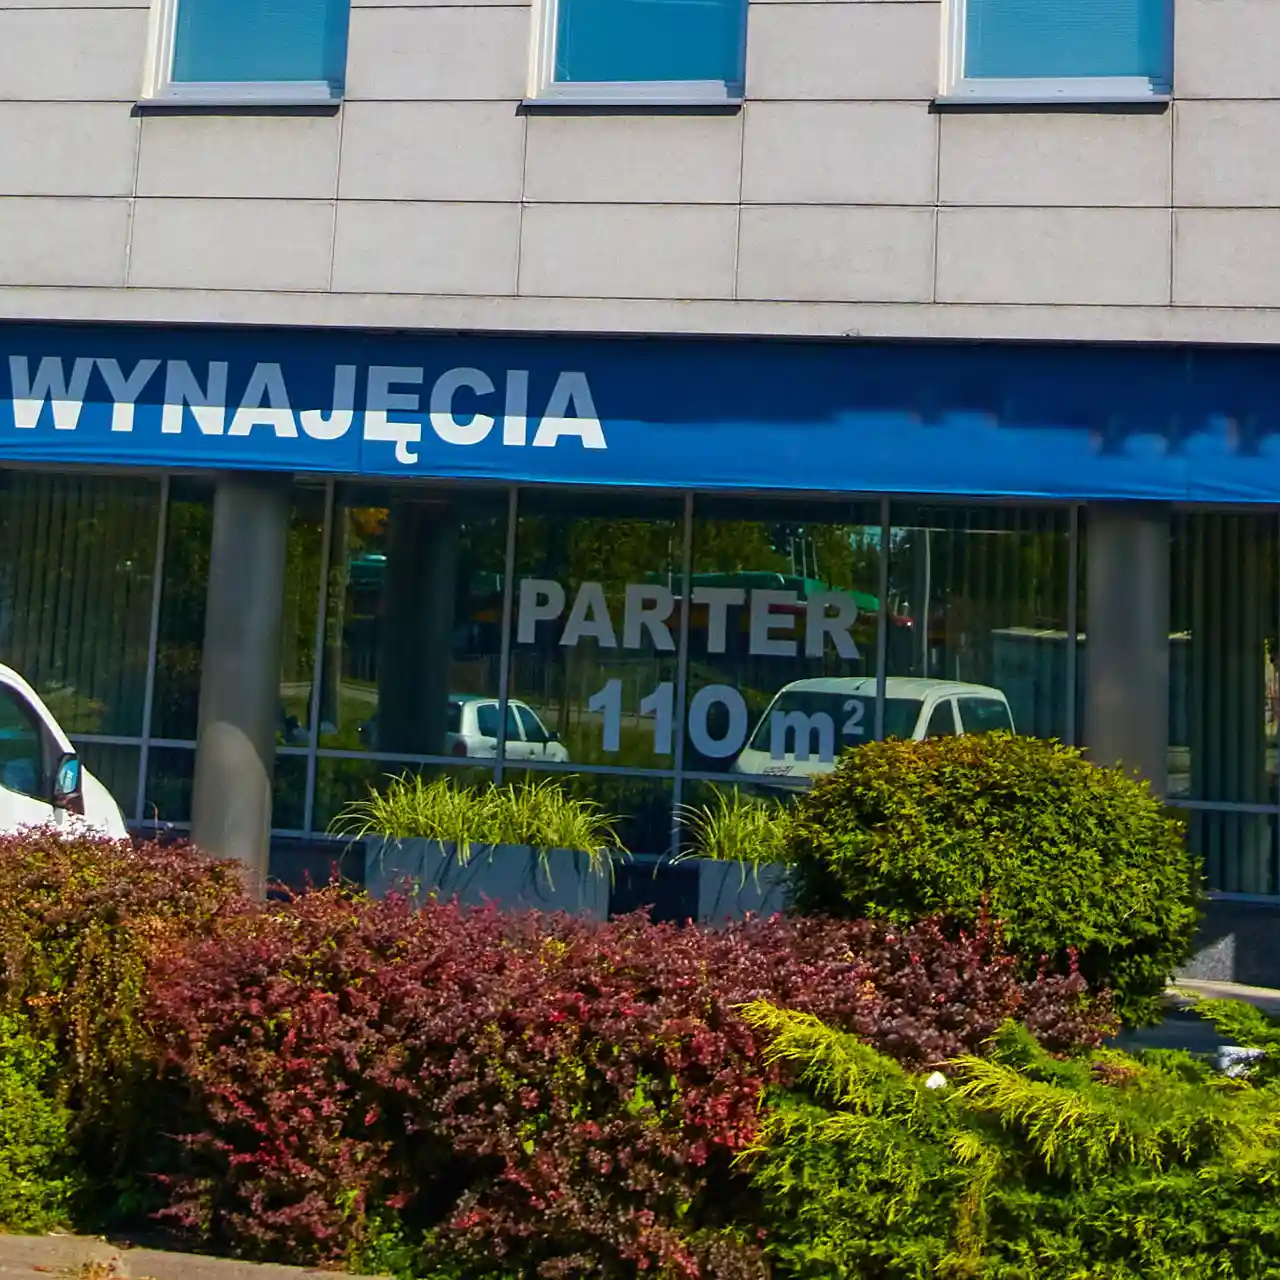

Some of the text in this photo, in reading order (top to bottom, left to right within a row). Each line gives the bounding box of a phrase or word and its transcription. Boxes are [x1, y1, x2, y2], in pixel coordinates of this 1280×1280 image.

[7, 356, 608, 464] WYNAJĘCIA
[517, 579, 861, 660] PARTER
[588, 679, 748, 759] 110
